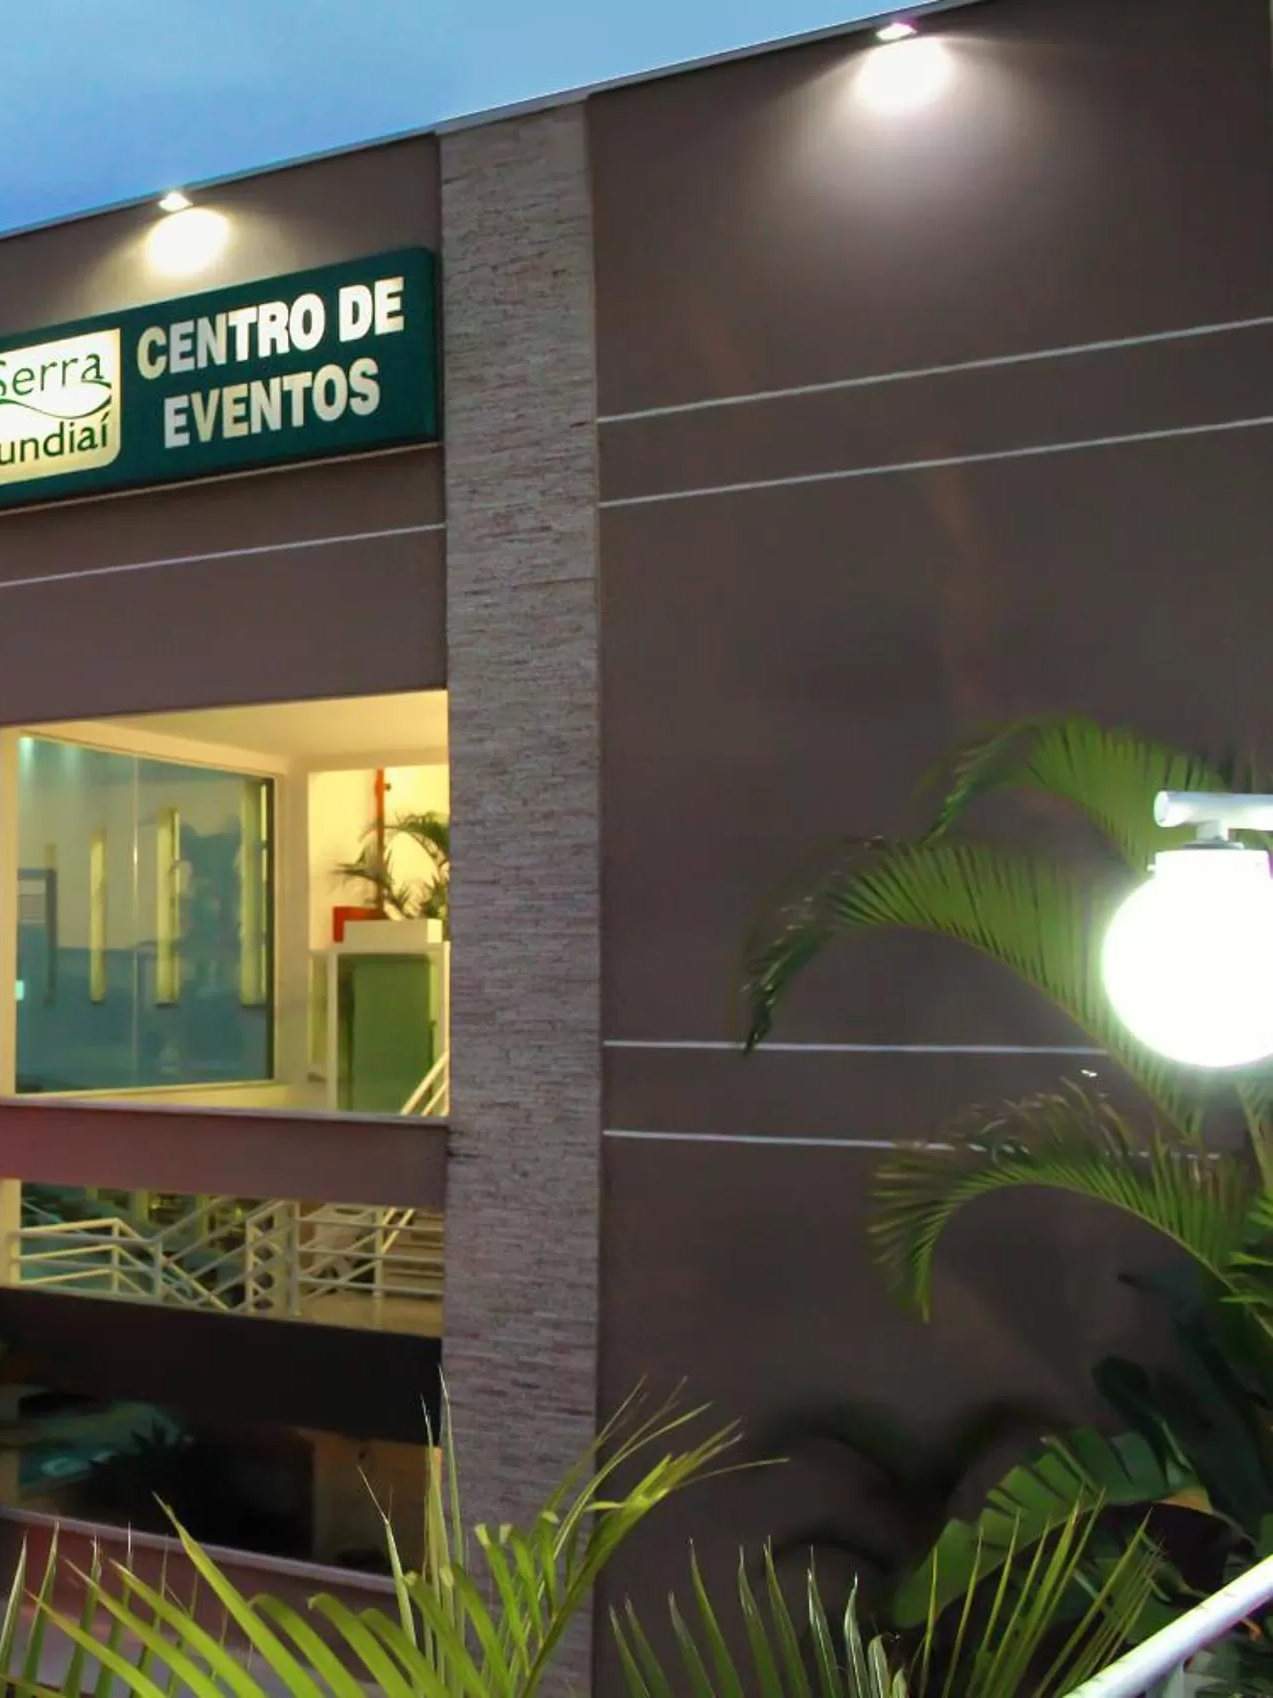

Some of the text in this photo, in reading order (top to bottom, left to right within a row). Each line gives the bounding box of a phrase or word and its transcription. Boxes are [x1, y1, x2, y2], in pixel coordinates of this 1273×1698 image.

[137, 276, 405, 380] CENTRO DE
[163, 357, 381, 449] EVENTOS
